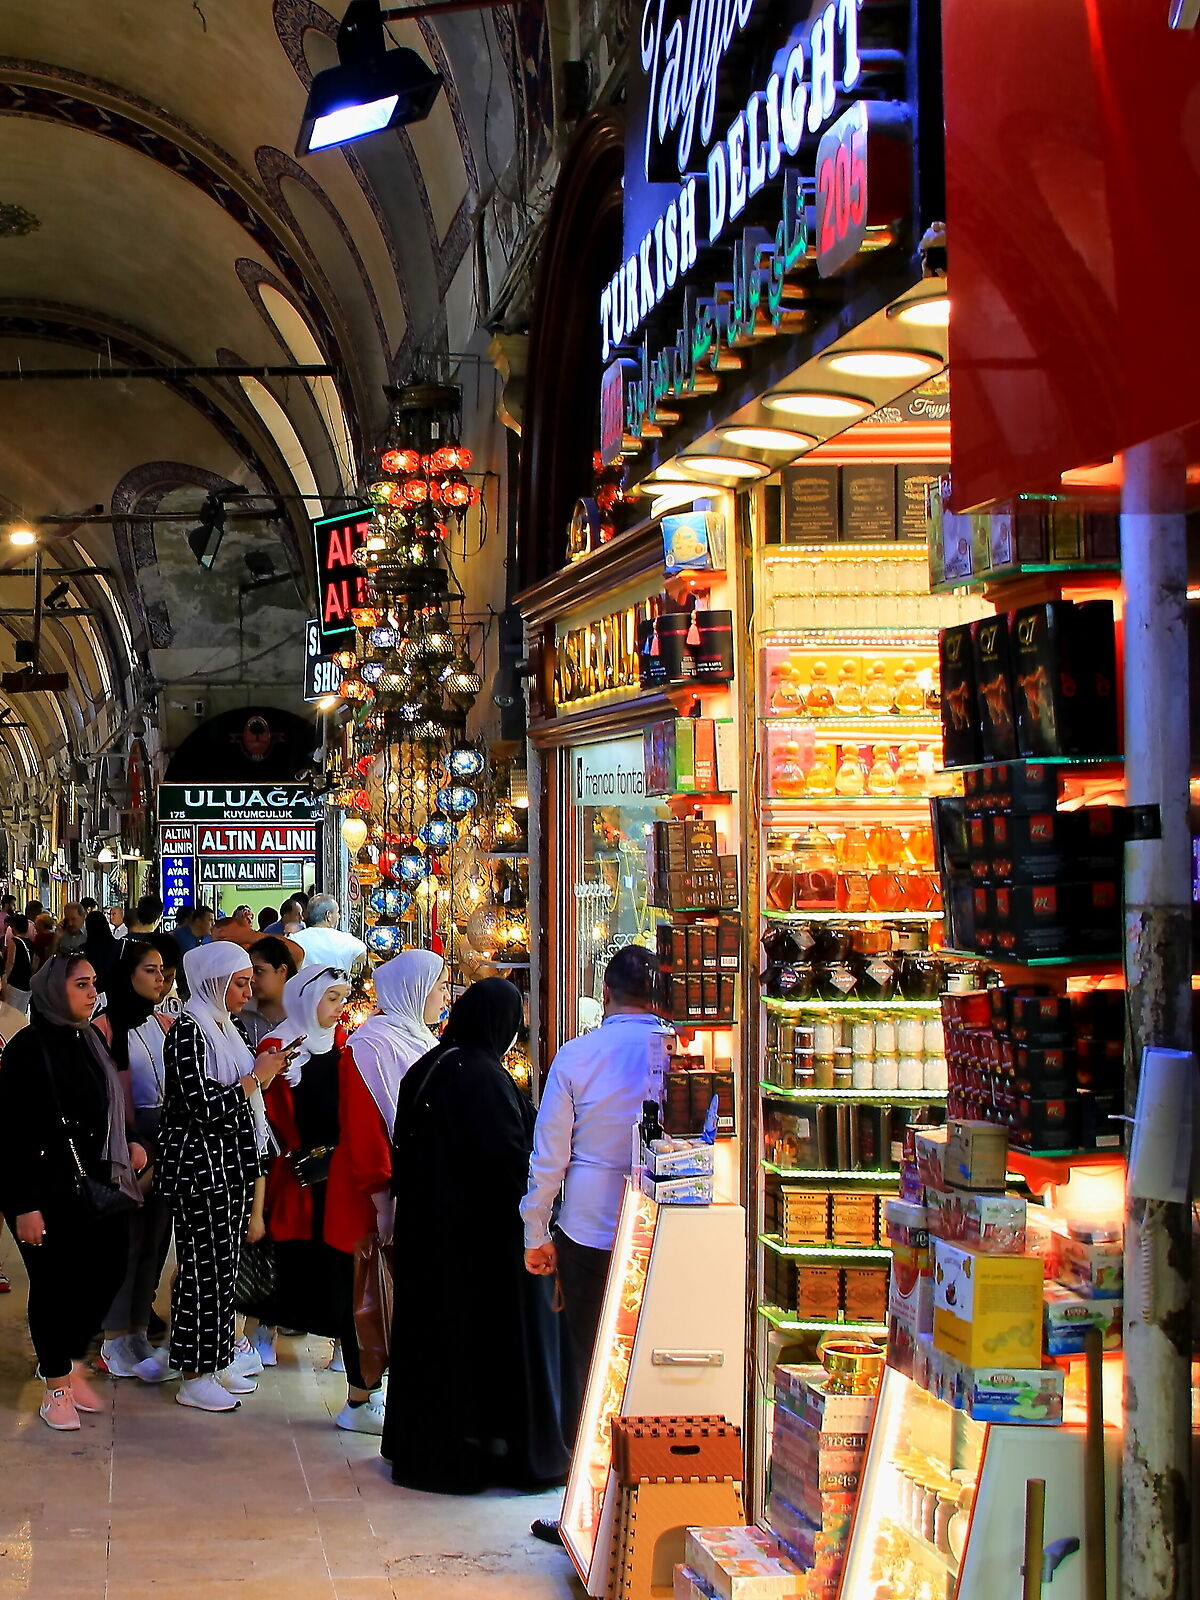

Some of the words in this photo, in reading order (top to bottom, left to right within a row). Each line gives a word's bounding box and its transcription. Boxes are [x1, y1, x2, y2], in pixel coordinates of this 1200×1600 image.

[600, 176, 698, 363] TURKISH
[707, 0, 862, 247] DELIGHT
[819, 127, 867, 256] 205
[585, 767, 615, 795] franco
[169, 811, 186, 819] 175
[223, 810, 293, 819] KUYUMCULUK
[165, 828, 191, 840] ALTIN
[201, 830, 256, 851] ALTIN
[163, 842, 193, 854] ALINIR
[173, 858, 183, 867] 14
[167, 867, 190, 876] AYAR
[203, 863, 236, 879] ALTIN
[237, 863, 277, 879] ALINIR
[173, 878, 184, 887] 18
[167, 887, 190, 897] AYAR
[168, 907, 179, 916] AY
